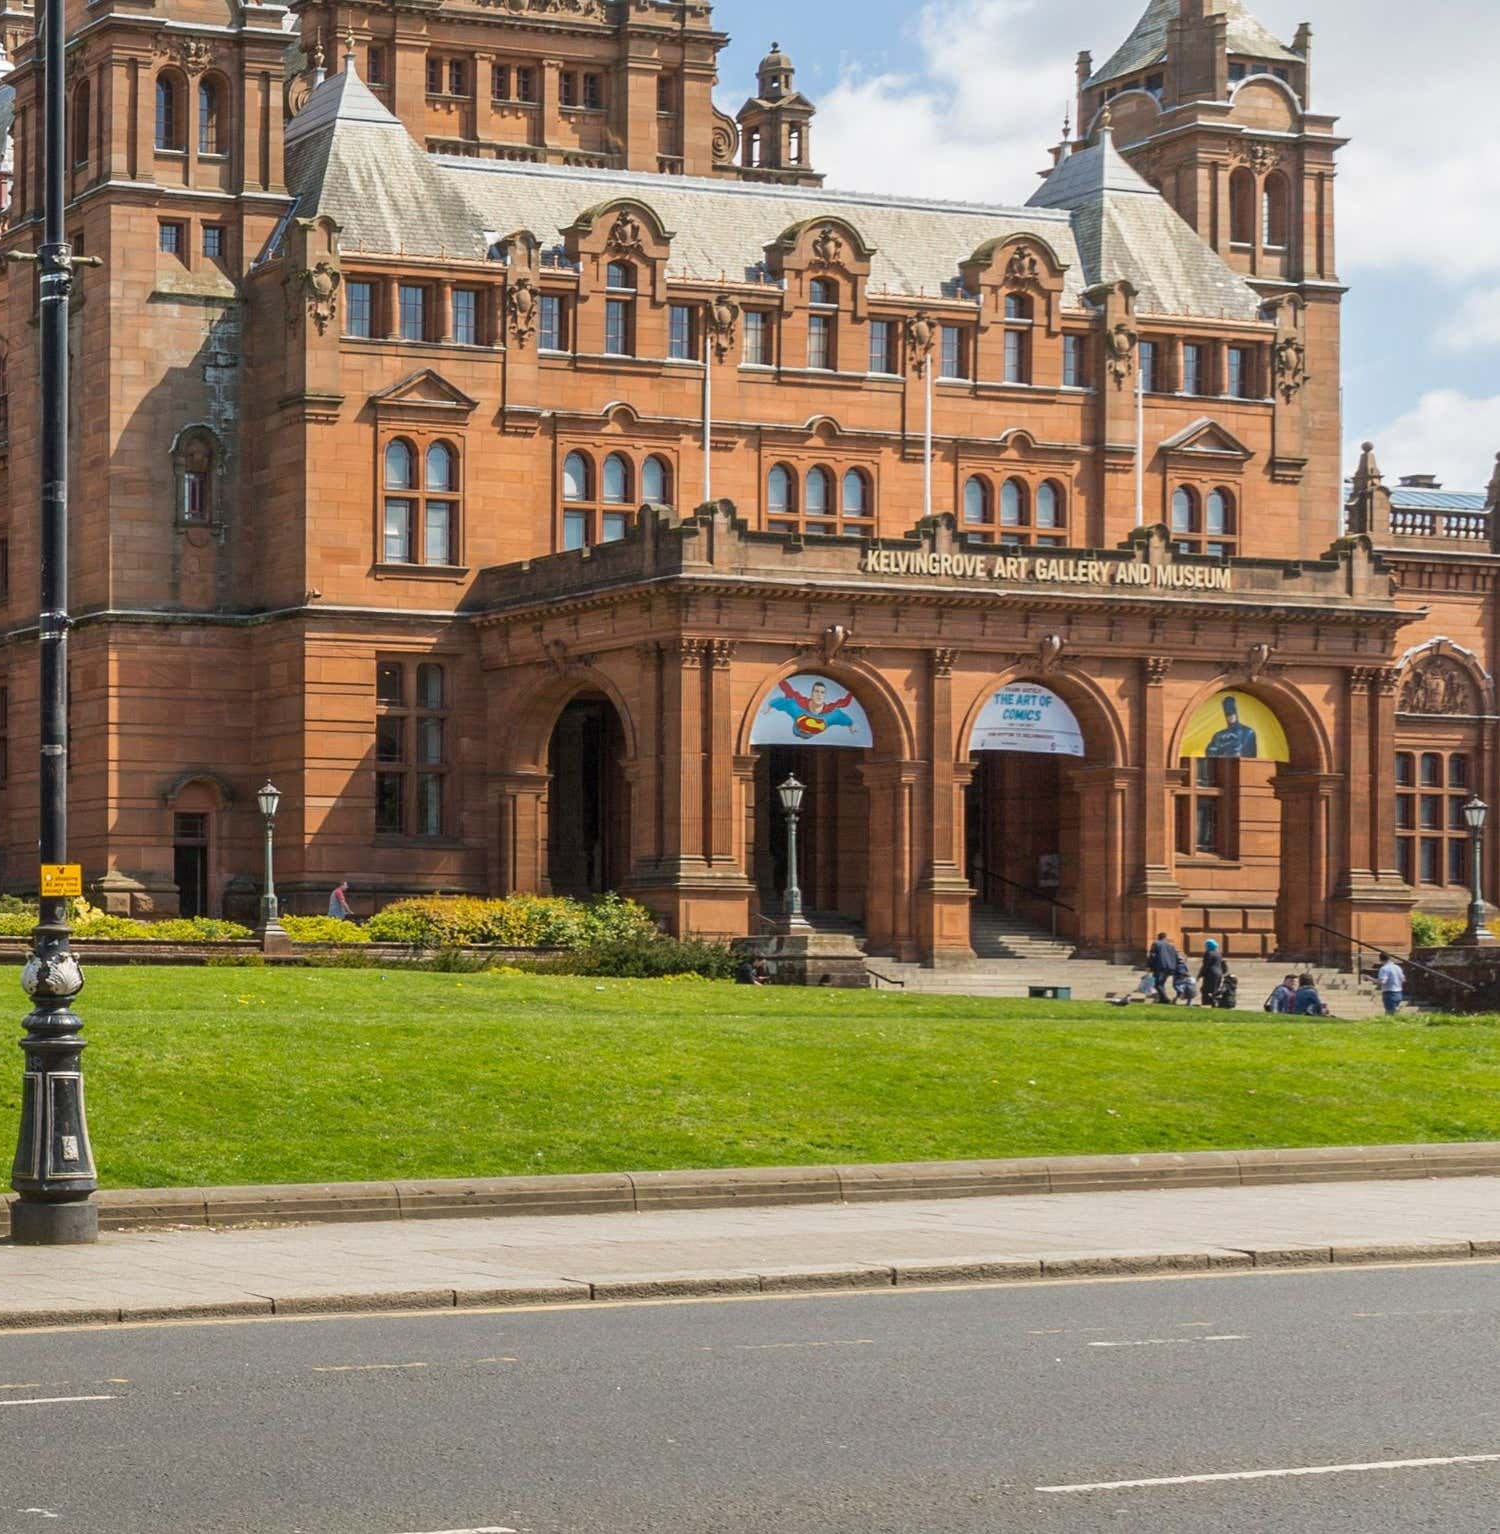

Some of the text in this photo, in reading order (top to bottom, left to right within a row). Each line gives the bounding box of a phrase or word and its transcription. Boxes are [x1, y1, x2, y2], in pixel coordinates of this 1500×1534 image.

[866, 550, 1232, 589] KELVINGROVE ART GALLERY AND MUSEUM
[993, 694, 1053, 707] THE ART OF
[1002, 709, 1042, 721] COMICS
